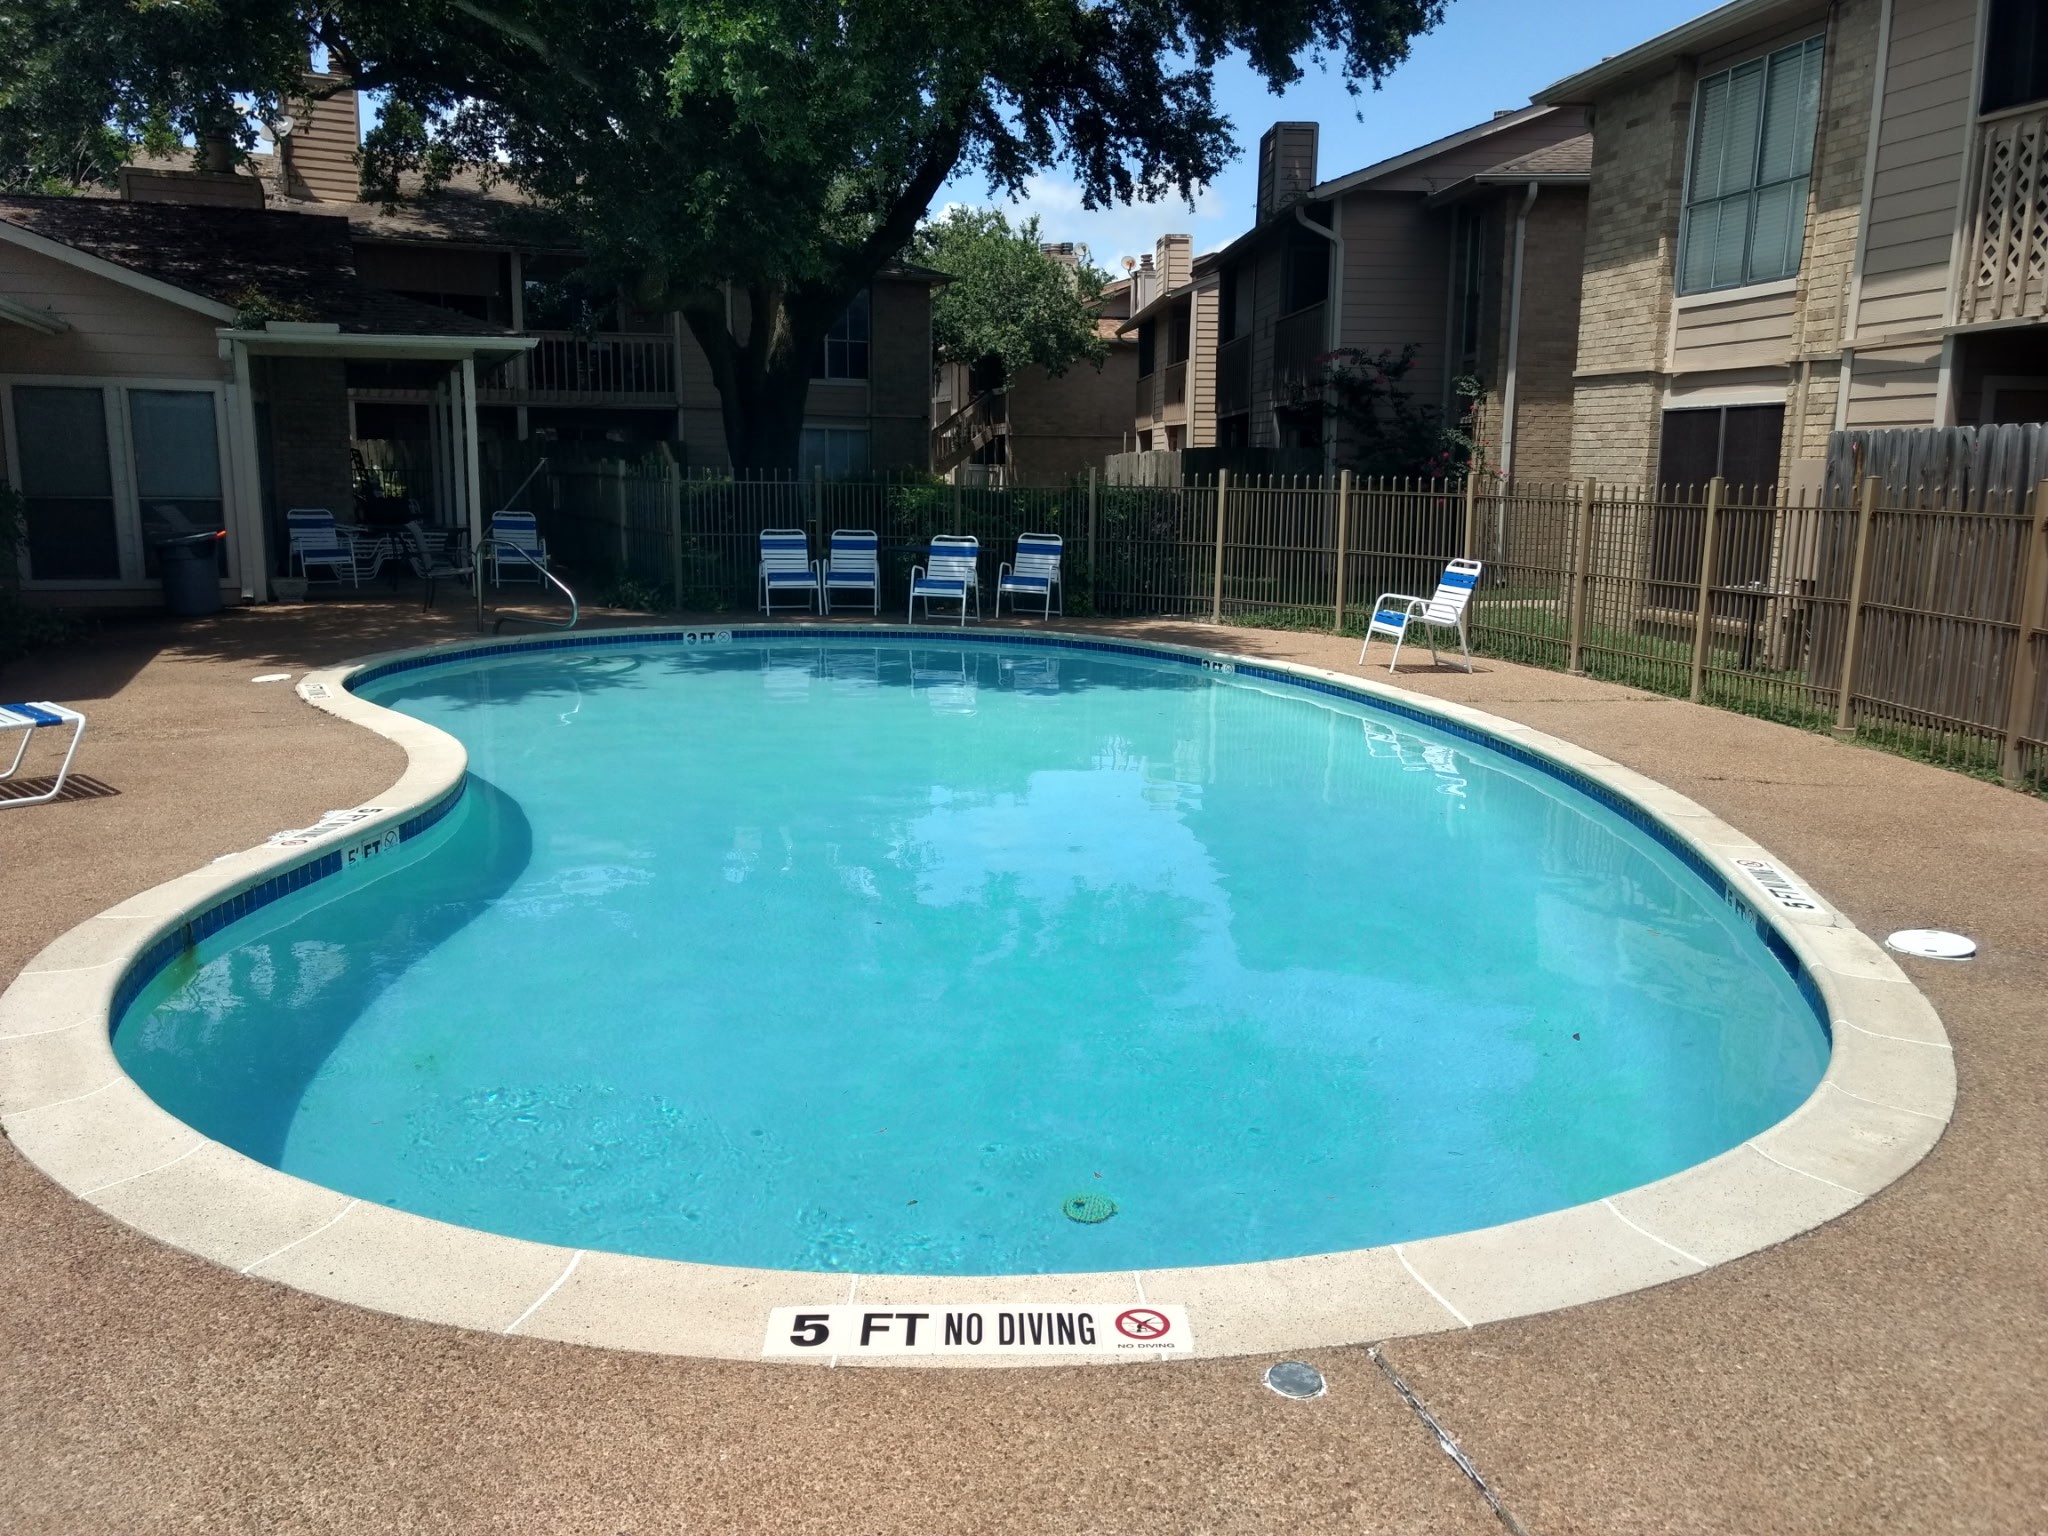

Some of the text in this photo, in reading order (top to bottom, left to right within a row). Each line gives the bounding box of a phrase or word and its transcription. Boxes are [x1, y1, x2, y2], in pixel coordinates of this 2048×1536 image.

[364, 840, 381, 858] FT
[790, 1312, 1096, 1347] 5 FT NO DIVING
